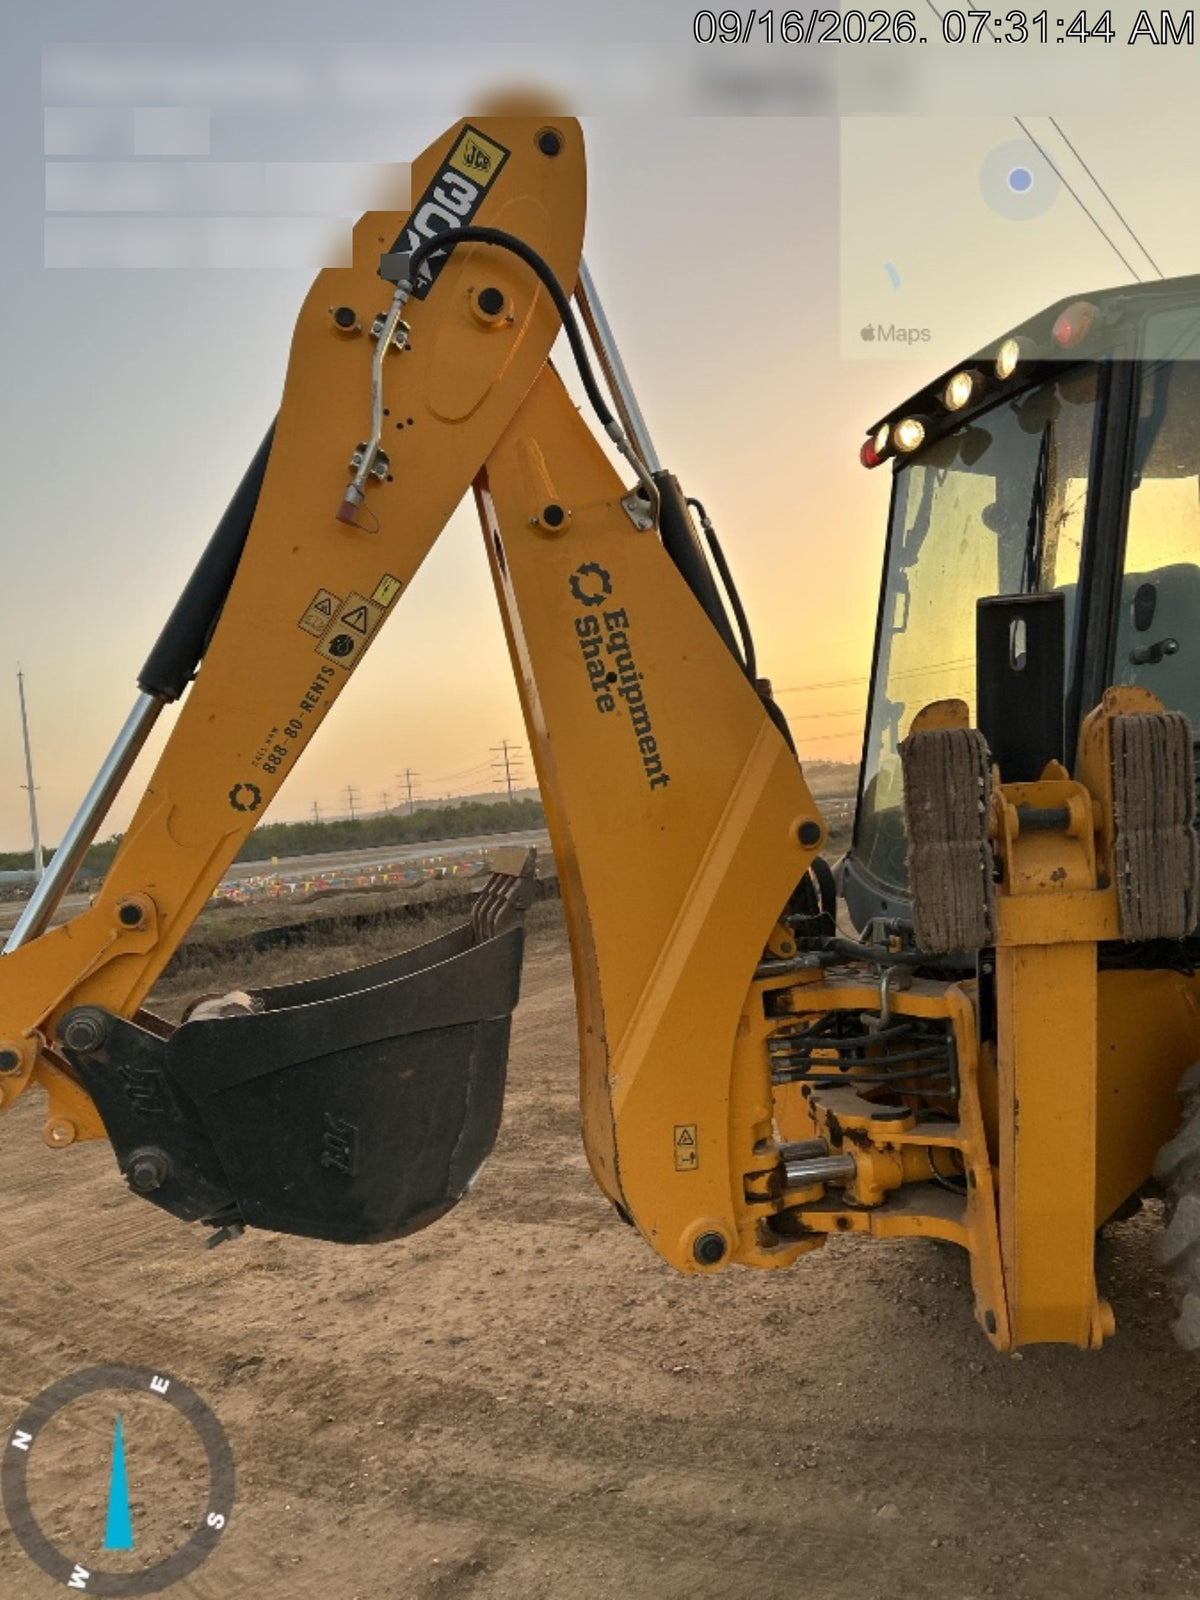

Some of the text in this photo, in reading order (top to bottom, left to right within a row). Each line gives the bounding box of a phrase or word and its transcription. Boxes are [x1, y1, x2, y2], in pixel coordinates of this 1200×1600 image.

[574, 614, 616, 714] Share
[602, 607, 671, 791] Equipment
[262, 665, 335, 774] 888-80-RENTS
